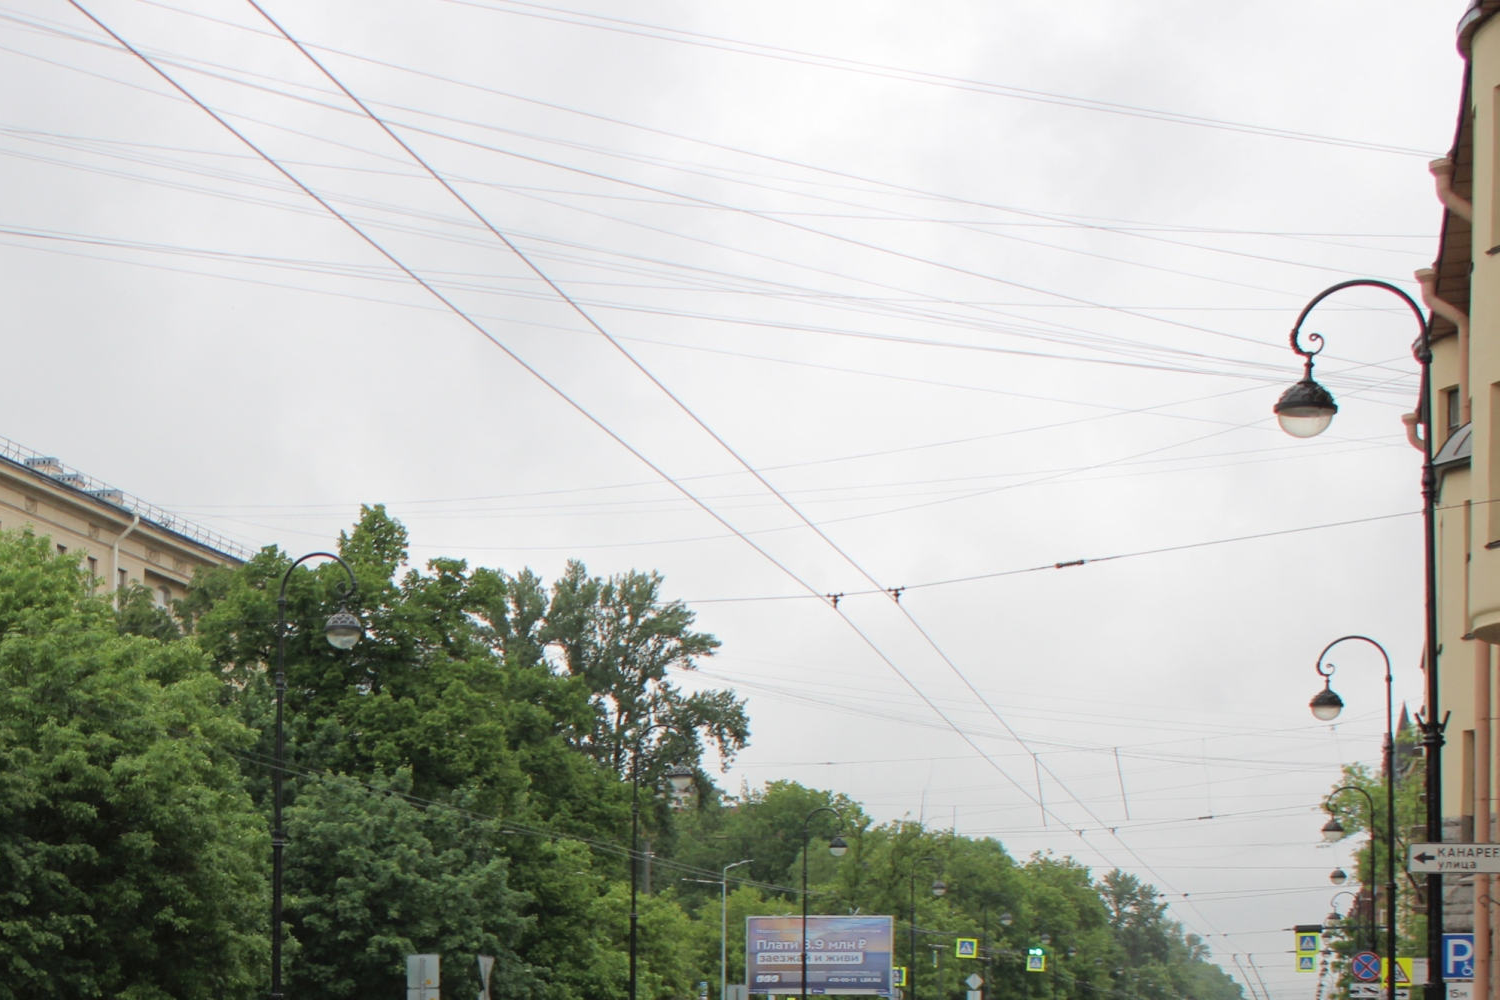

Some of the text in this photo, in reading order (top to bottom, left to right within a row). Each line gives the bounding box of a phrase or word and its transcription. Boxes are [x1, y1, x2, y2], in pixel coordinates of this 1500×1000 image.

[1437, 861, 1476, 870] улица
[756, 940, 799, 950] Плати
[828, 941, 856, 950] млн
[826, 954, 860, 962] живи
